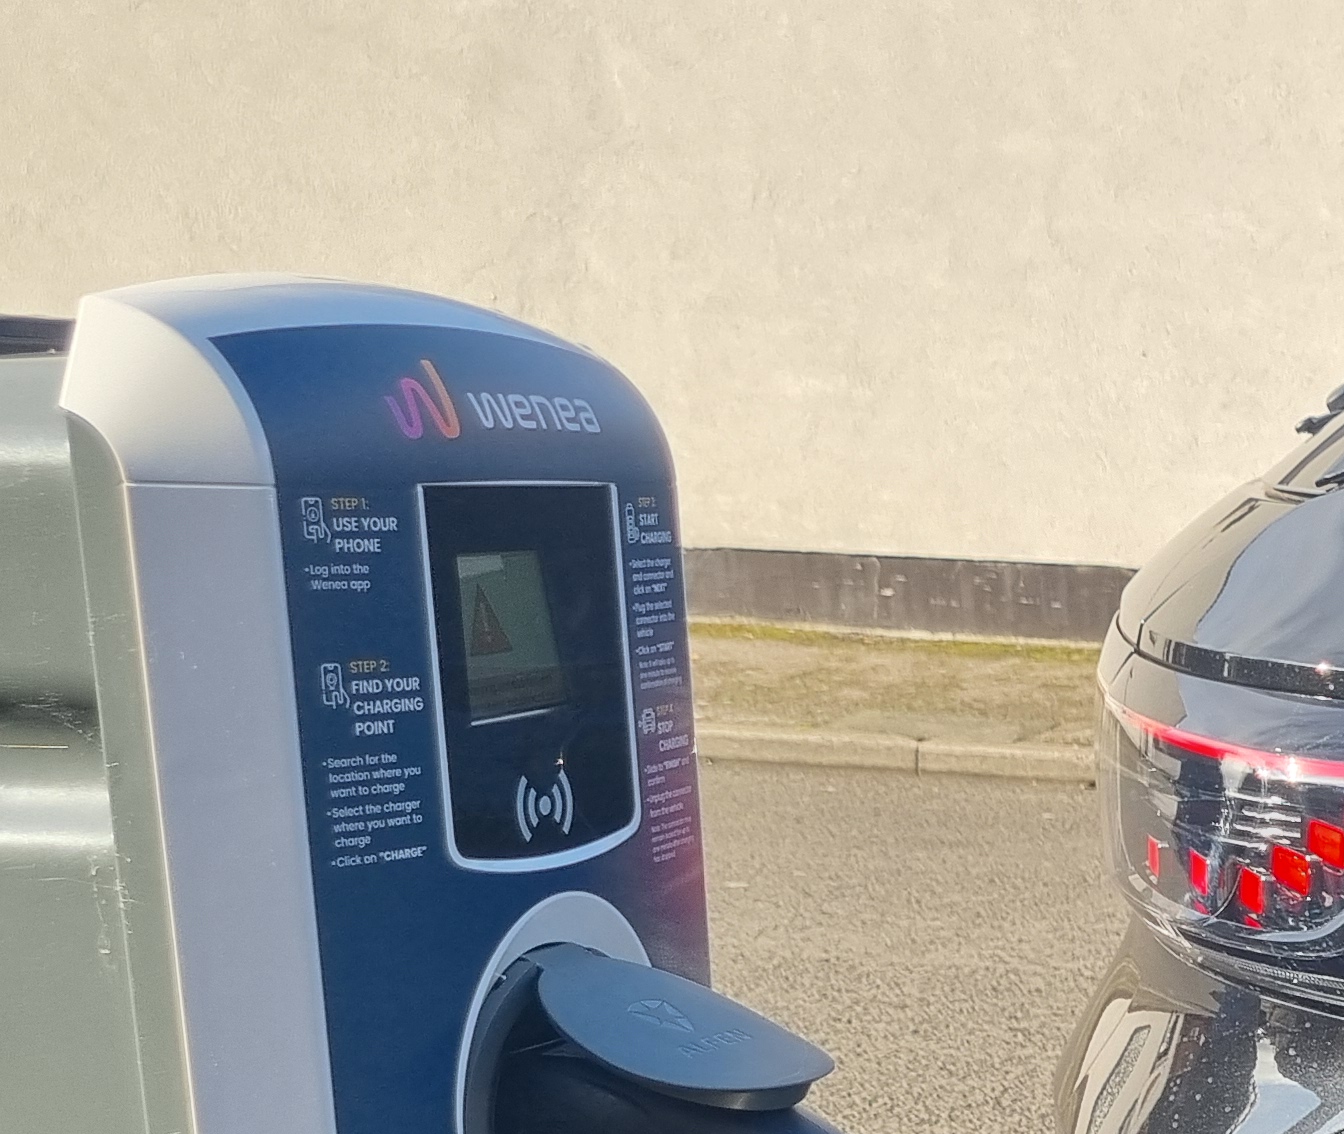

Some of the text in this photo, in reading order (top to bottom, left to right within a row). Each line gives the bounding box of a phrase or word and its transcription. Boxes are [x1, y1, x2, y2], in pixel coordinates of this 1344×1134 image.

[467, 391, 601, 433] wenea
[331, 498, 370, 510] STEP 1:
[638, 497, 650, 508] STEP
[333, 517, 399, 532] USE YOUR
[640, 514, 658, 526] START
[641, 531, 672, 544] CHARGING
[335, 538, 382, 553] PHONE
[310, 564, 370, 578] Log into the
[311, 580, 371, 592] Wenea app
[350, 660, 390, 673] STEP 2:
[352, 677, 420, 694] FIND YOUR
[354, 698, 424, 715] CHARGING
[355, 720, 395, 736] POINT
[658, 720, 674, 735] STOP
[659, 734, 689, 752] CHARGING
[328, 753, 397, 769] Search for the
[329, 767, 421, 783] location where you
[331, 783, 405, 798] want to charge
[332, 800, 421, 818] Select the charger
[334, 814, 423, 833] where you want to
[335, 836, 371, 848] charge
[337, 855, 362, 868] Click
[364, 855, 377, 864] on
[677, 1028, 753, 1060] ALFEN
